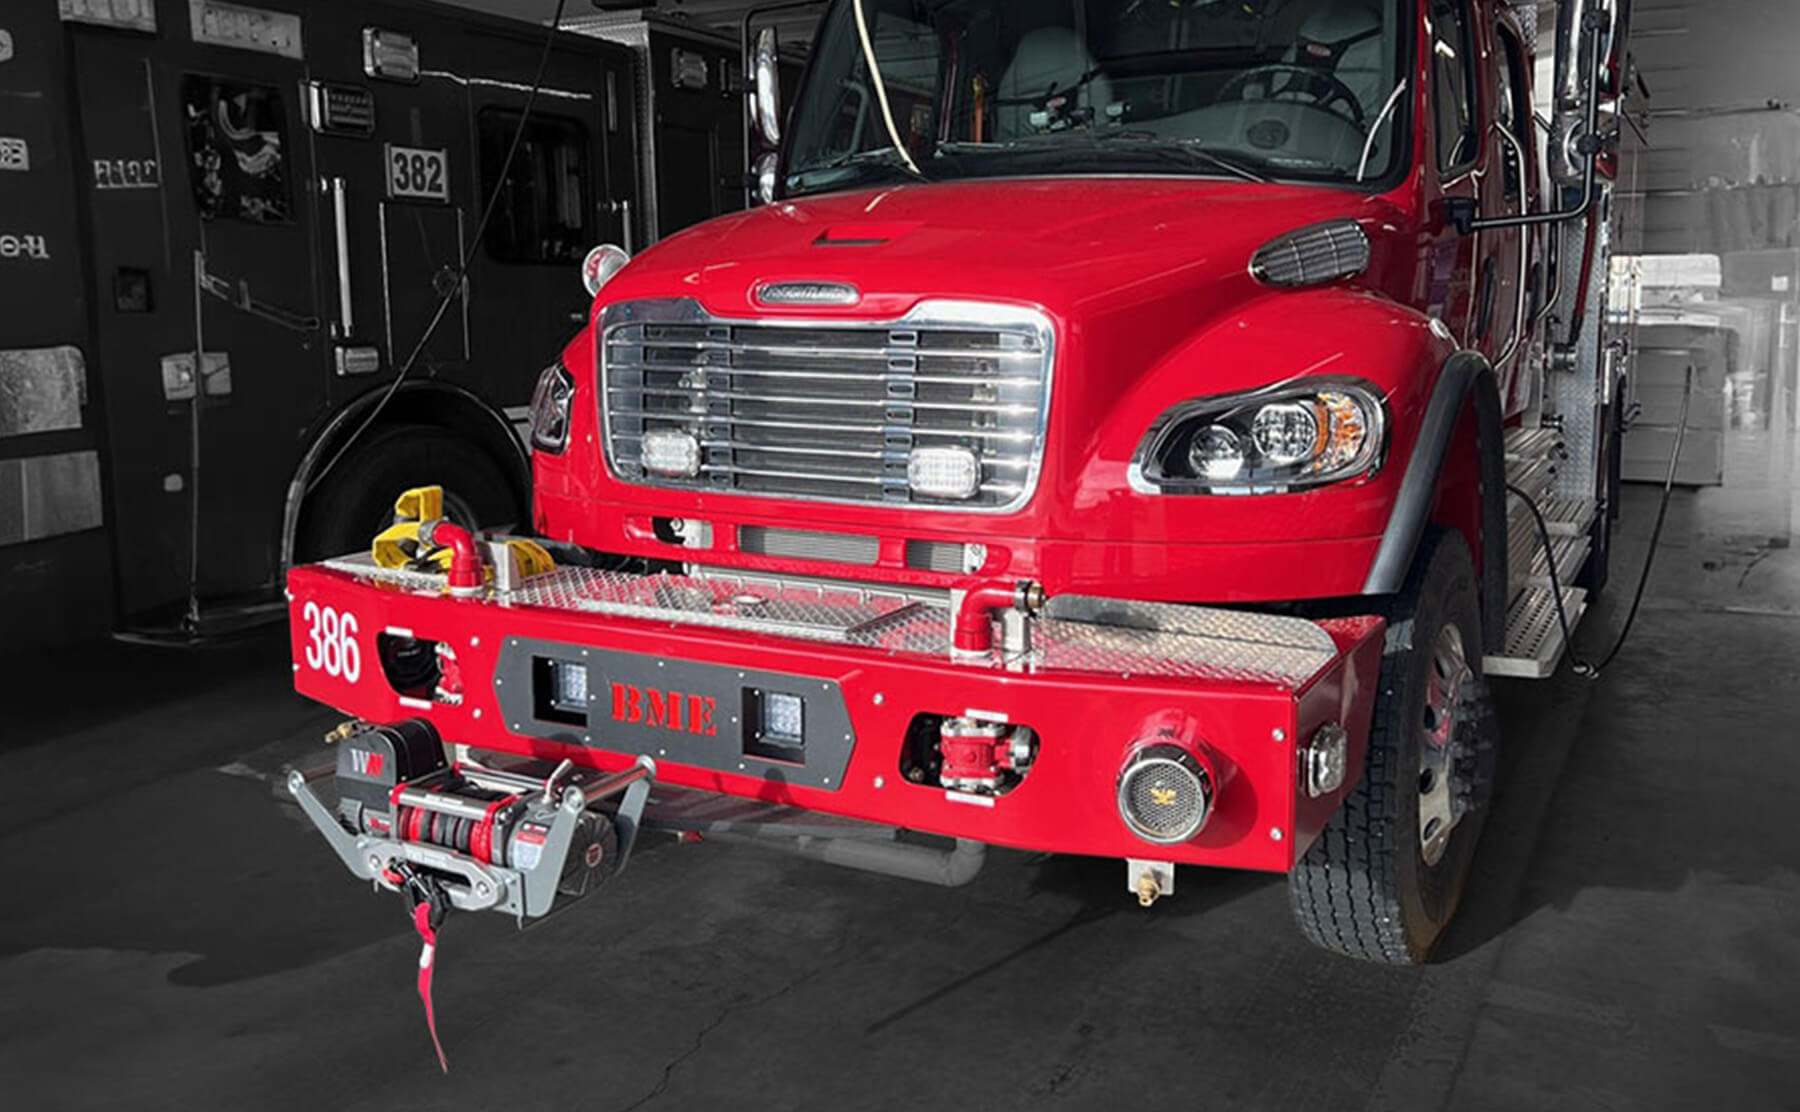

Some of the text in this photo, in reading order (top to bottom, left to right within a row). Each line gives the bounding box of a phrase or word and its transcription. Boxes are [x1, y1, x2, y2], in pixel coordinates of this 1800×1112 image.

[394, 152, 443, 193] 382
[303, 601, 360, 683] 386
[611, 681, 717, 737] BME
